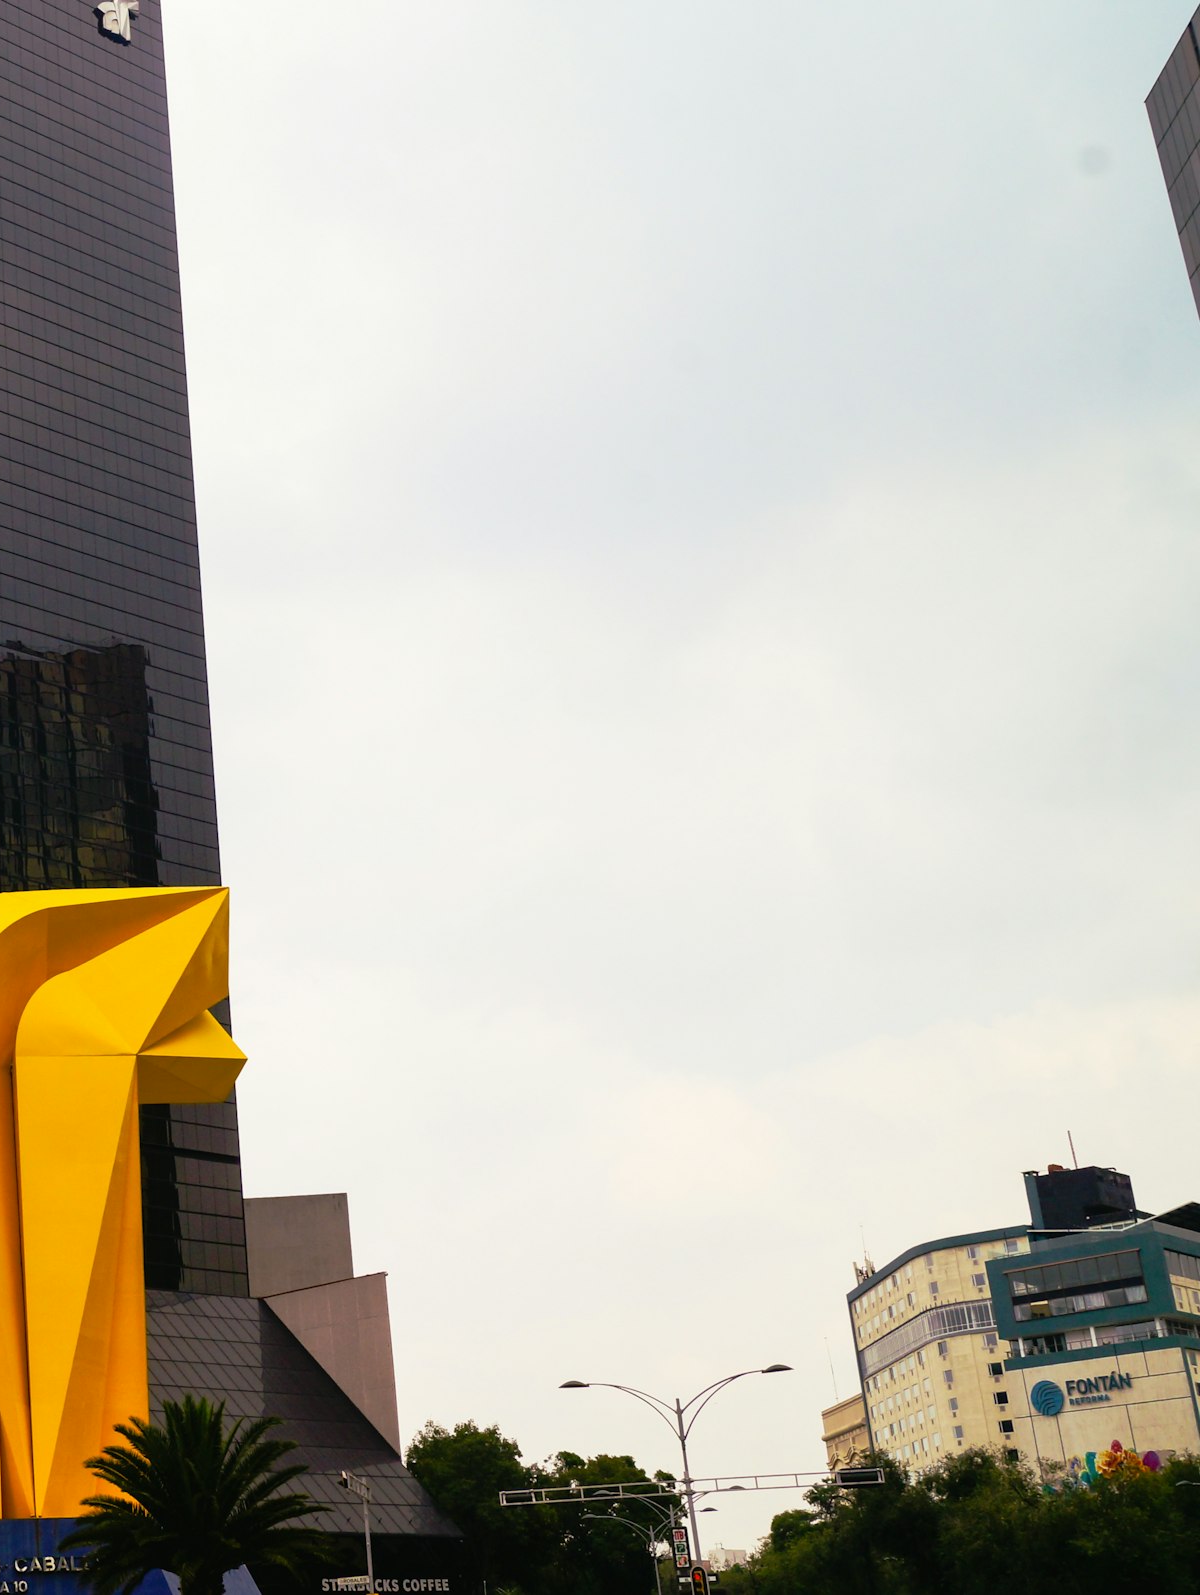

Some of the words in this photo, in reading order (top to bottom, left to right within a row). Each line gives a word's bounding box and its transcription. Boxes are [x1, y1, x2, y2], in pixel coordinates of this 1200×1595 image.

[1065, 1371, 1132, 1396] FONTÁN
[1069, 1394, 1111, 1405] REFORMA
[13, 1580, 28, 1593] 10
[402, 1578, 450, 1592] COFFEE
